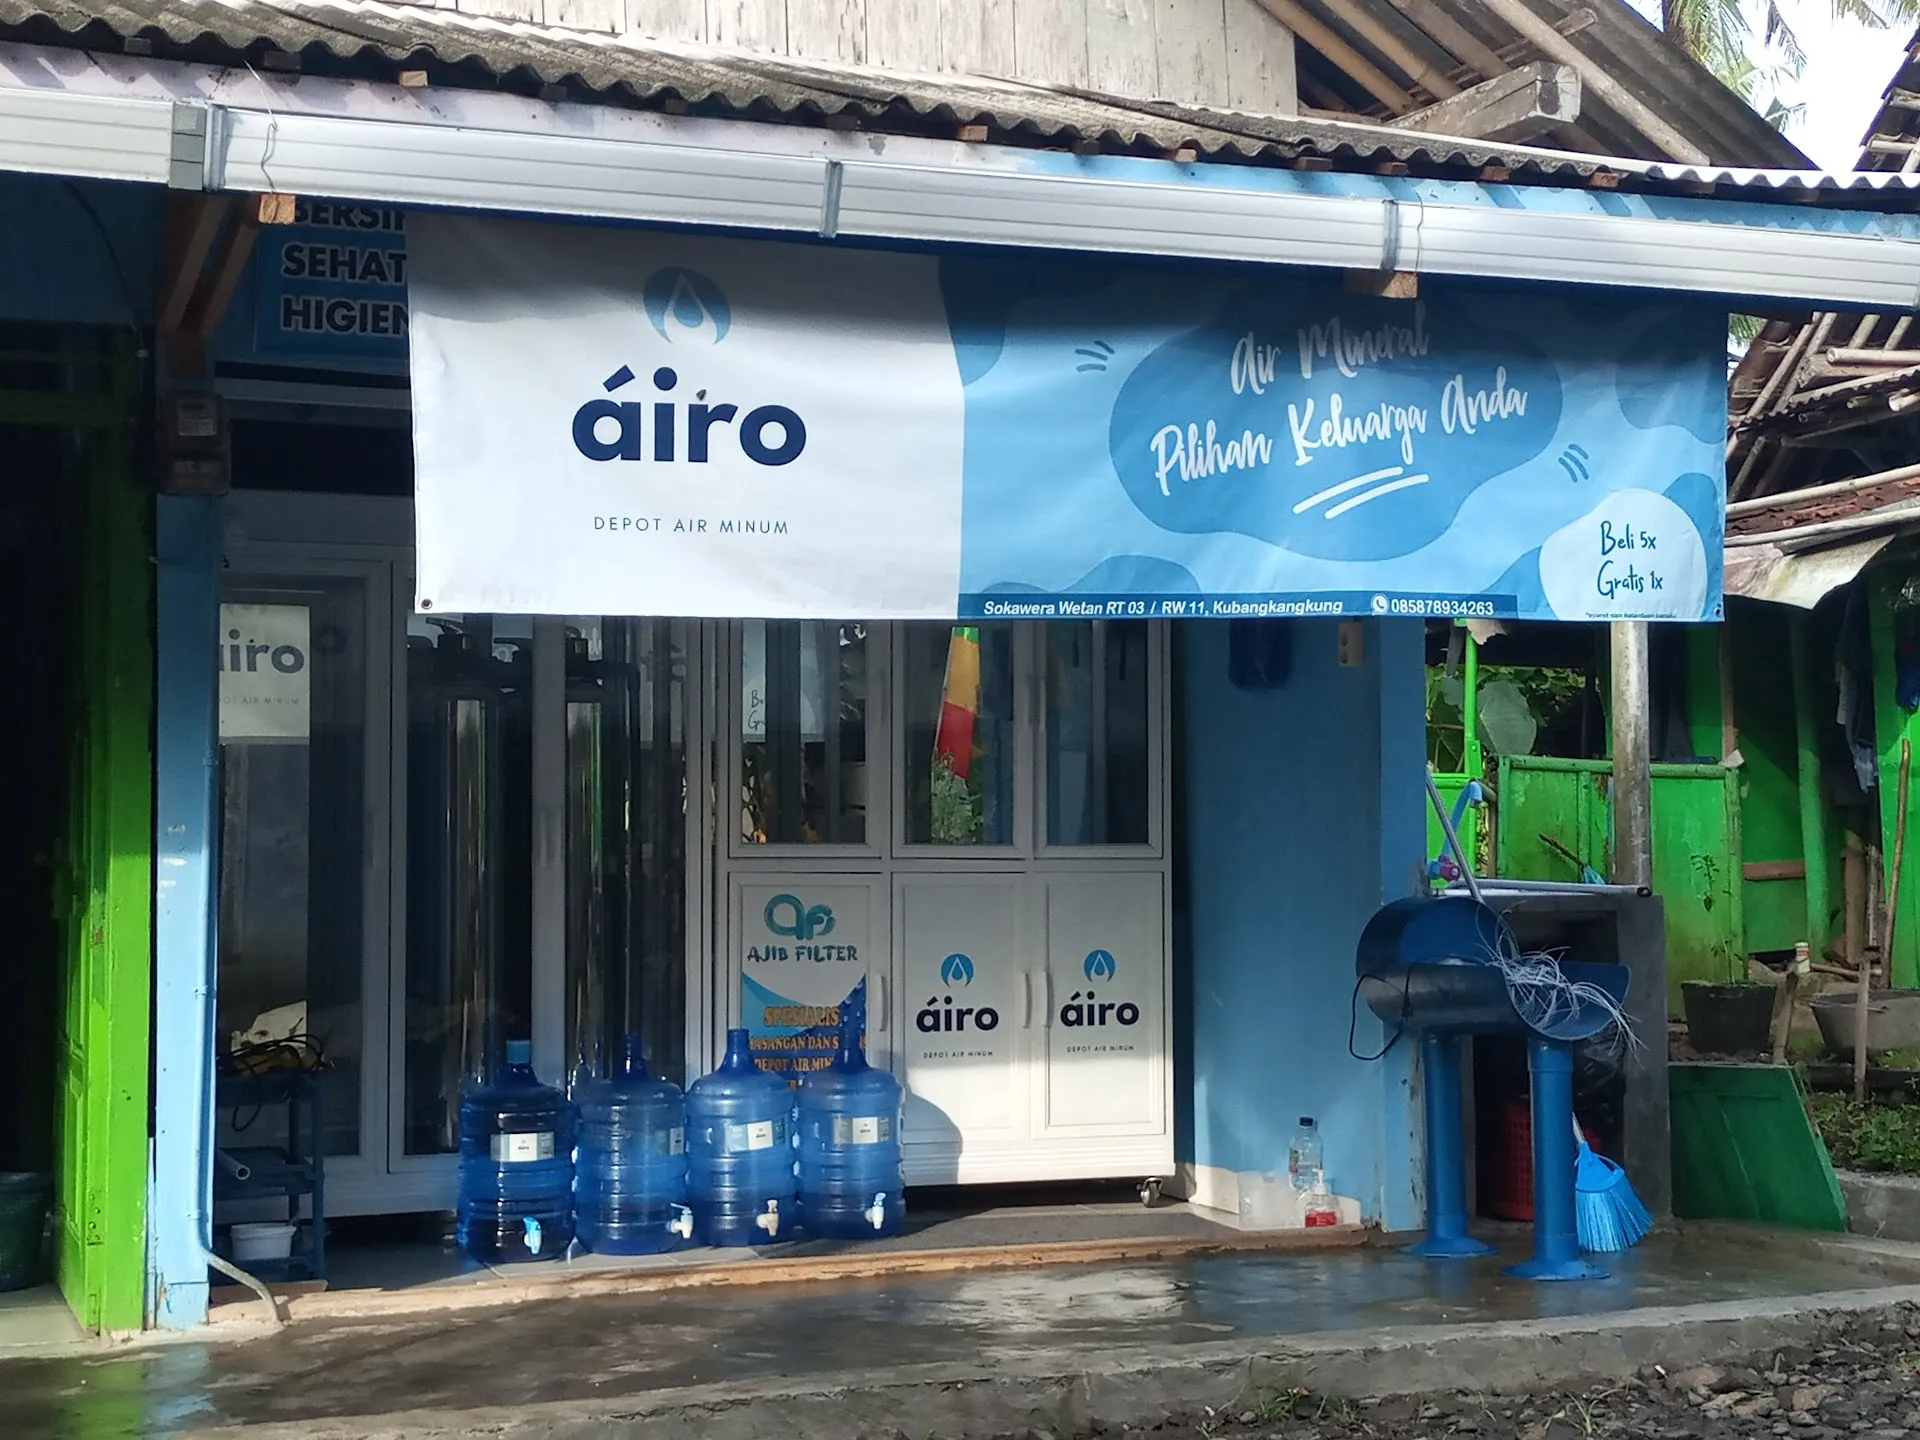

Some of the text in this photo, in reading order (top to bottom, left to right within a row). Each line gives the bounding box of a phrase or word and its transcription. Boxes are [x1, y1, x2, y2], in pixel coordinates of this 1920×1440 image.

[281, 243, 407, 283] SEHAT
[1230, 300, 1430, 395] Air Mineral
[572, 364, 807, 467] áiro
[1150, 365, 1528, 496] Pilihan Keluarga Anda
[594, 517, 789, 535] DEPOT AIR MINUM
[1600, 520, 1656, 555] Beli 5x
[1597, 560, 1663, 599] Gratis 1x
[983, 600, 1055, 615] Sokawera
[1058, 601, 1103, 615] Wetan
[1105, 601, 1125, 615] RT
[1127, 601, 1145, 615] 03
[1161, 600, 1186, 615] RW
[1188, 601, 1209, 617] 11,
[1213, 599, 1343, 617] Kubangkangkung
[1391, 600, 1494, 615] 085878934263
[219, 629, 305, 674] iro
[747, 945, 858, 962] AJIB FILTER
[763, 1005, 840, 1028] SPESIALIS
[916, 995, 999, 1033] áiro
[1060, 990, 1140, 1027] áiro
[791, 1057, 810, 1072] AIR
